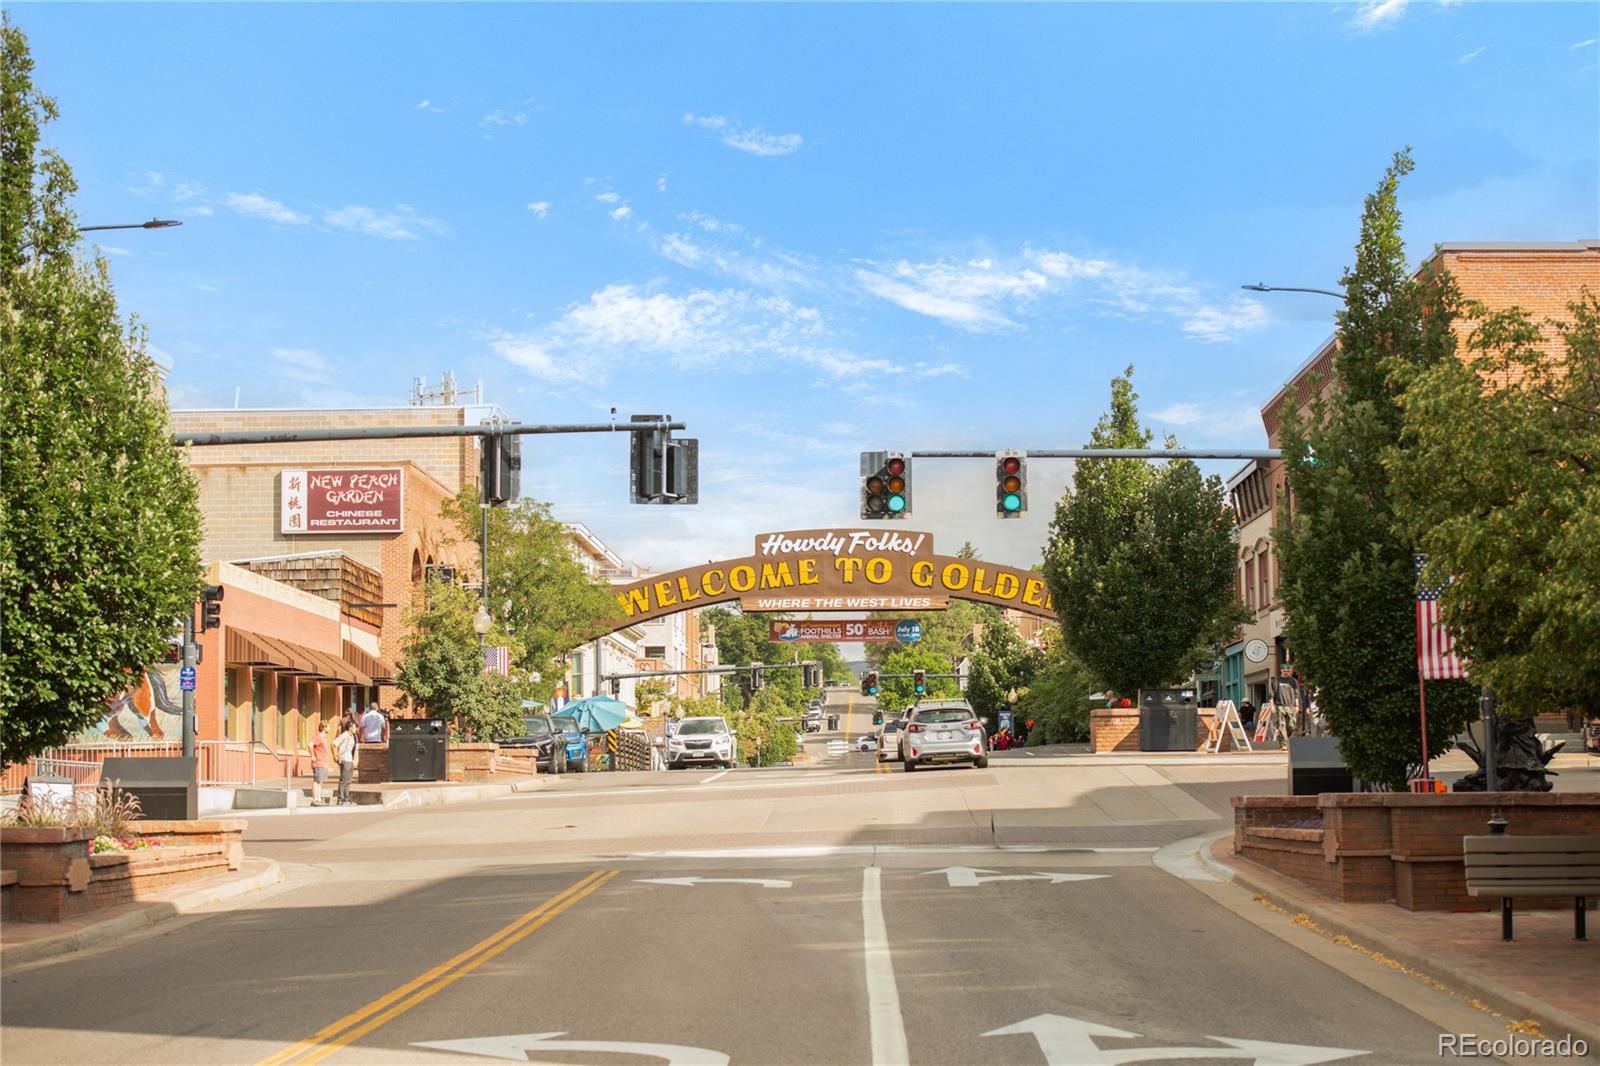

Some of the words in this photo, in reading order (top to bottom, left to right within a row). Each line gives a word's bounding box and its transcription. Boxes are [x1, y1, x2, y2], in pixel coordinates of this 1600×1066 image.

[310, 475, 343, 490] NEW
[350, 473, 399, 490] PEACH
[326, 489, 384, 506] GARDEN
[326, 510, 383, 518] CHINESE
[310, 518, 399, 527] RESTAURANT
[761, 532, 846, 556] Howdy
[847, 531, 925, 556] Folks!
[616, 558, 820, 617] WELCOME
[834, 556, 893, 584] TO
[758, 598, 810, 608] WHERE
[814, 598, 844, 608] THE
[846, 598, 887, 608] WEST
[891, 597, 931, 607] LIVES
[800, 627, 842, 635] FOOTHILLS
[868, 627, 890, 635] BASH
[897, 626, 910, 634] July
